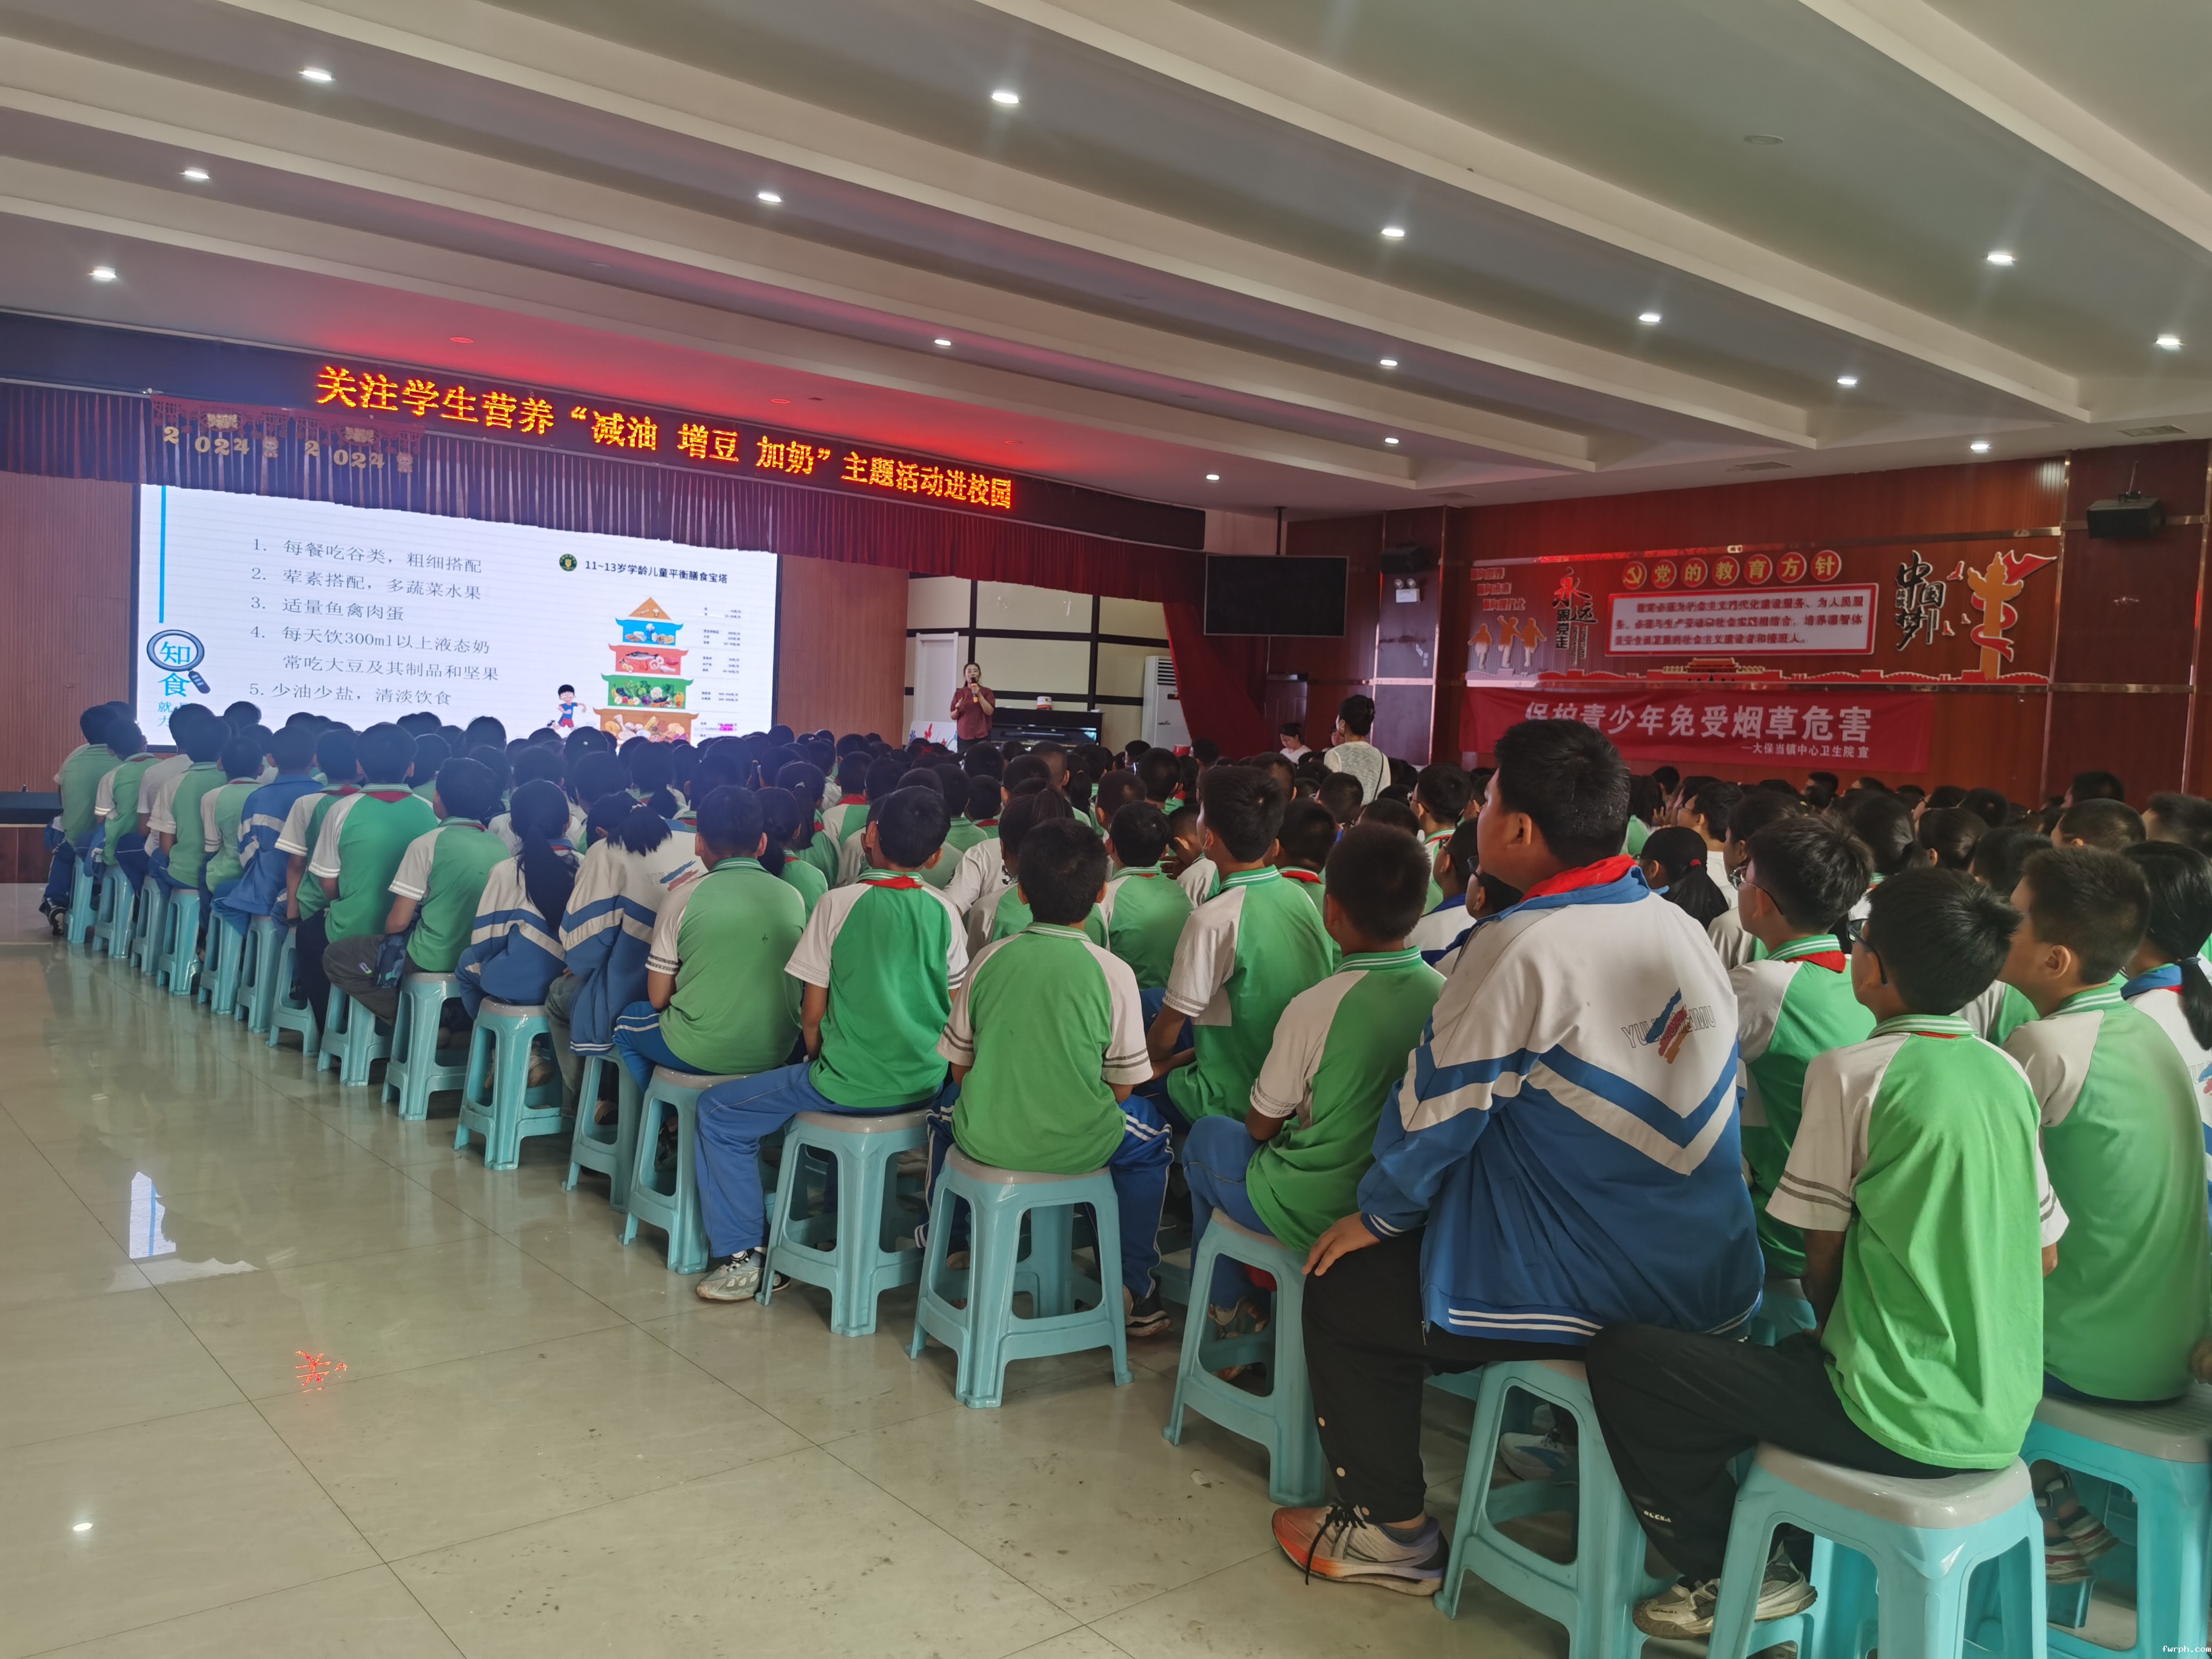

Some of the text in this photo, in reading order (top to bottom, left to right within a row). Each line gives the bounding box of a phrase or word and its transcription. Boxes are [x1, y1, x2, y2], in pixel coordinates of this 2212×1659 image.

[315, 365, 555, 435] 关注学生营养
[677, 423, 740, 462] 增豆
[841, 451, 1012, 509] 主题活动进校园
[253, 538, 483, 574] 1. 每餐吃谷类，粗细搭配
[1654, 555, 1835, 583] 党的教育方针
[250, 567, 483, 600] 2. 荤素搭配，多蔬菜水果
[585, 560, 729, 585] 11~13岁学龄儿童平衡膳食宝塔
[250, 596, 404, 622] 3. 适量鱼禽肉蛋
[250, 625, 490, 654] 4. 每天饮300ml以上液态奶
[283, 654, 499, 681] 常吃大豆及其制品和坚果
[249, 682, 452, 706] 5. 少油少盐，清淡饮食
[1525, 701, 1872, 743] 保护青少年免受烟草危害
